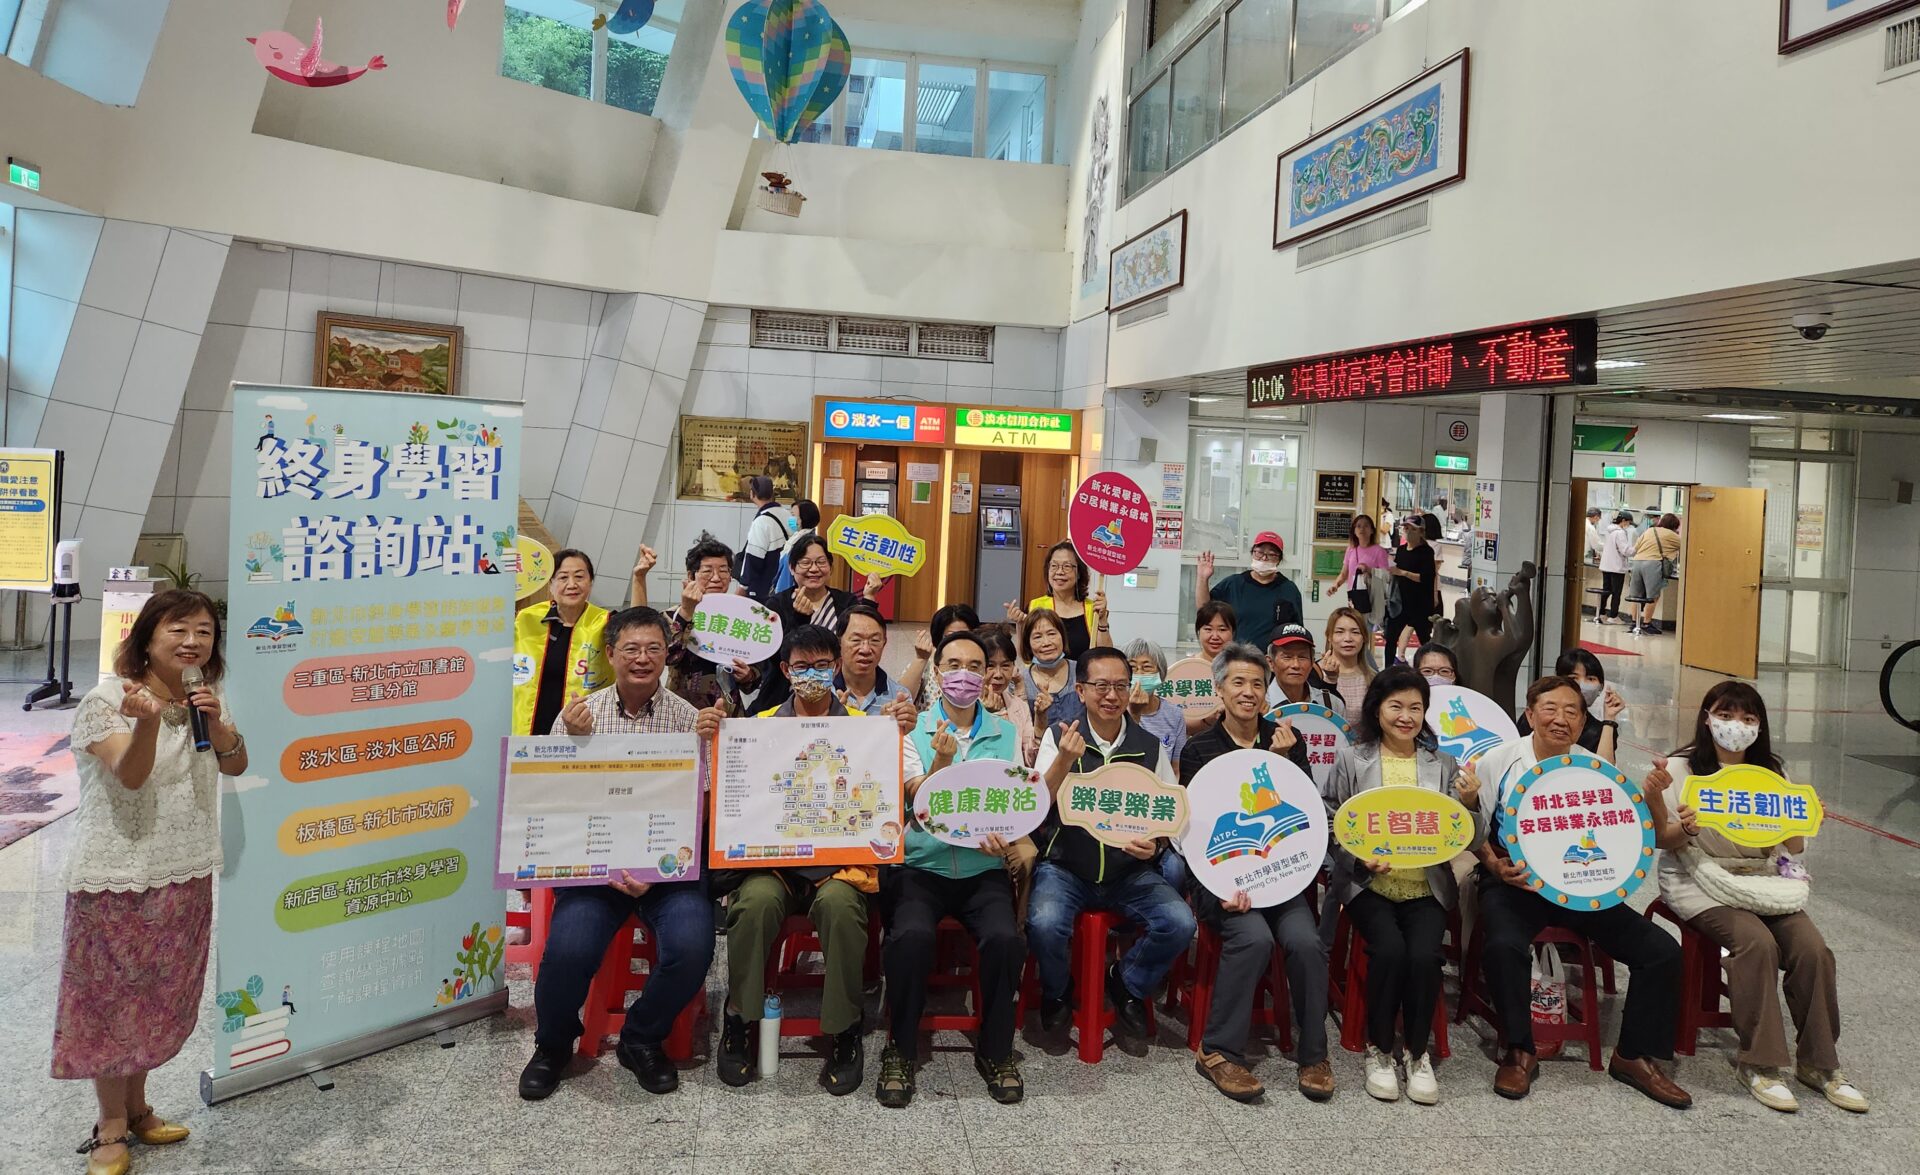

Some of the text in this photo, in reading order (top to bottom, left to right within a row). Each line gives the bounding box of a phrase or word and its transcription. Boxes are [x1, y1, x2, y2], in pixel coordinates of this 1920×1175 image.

[1252, 374, 1285, 402] 10:06
[851, 413, 911, 430] 淡水一信
[919, 416, 941, 426] ATM
[984, 412, 1061, 429] 淡水信用合作社
[992, 431, 1037, 446] ATM
[256, 438, 502, 500] 終身學習
[1091, 480, 1142, 504] 新北愛學習
[1079, 492, 1149, 523] 安居樂業永續城
[282, 514, 484, 582] 諮詢站
[839, 526, 917, 564] 生活韌性
[292, 656, 467, 689] 三重區-新北市立圖書館
[350, 681, 419, 702] 三重分館
[1156, 678, 1218, 698] 樂學樂
[298, 730, 457, 770] 淡水區-淡水區公所
[928, 786, 1038, 817] 健康樂活
[1070, 785, 1176, 822] 樂學樂業
[1531, 788, 1614, 811] 新北愛學習
[1699, 788, 1809, 820] 生活韌性
[296, 798, 454, 844] 板橋區-新北市政府
[1367, 810, 1440, 835] E智慧
[1519, 808, 1635, 835] 安居樂業永續城
[1213, 829, 1238, 844] NTPC
[284, 856, 460, 910] 新店區-新北市終身學習
[1234, 850, 1310, 888] 新北市學習型城市
[1242, 862, 1312, 893] earning City, New Taipei
[1563, 868, 1616, 880] 新北市學習型城市
[344, 888, 412, 917] 資源中心
